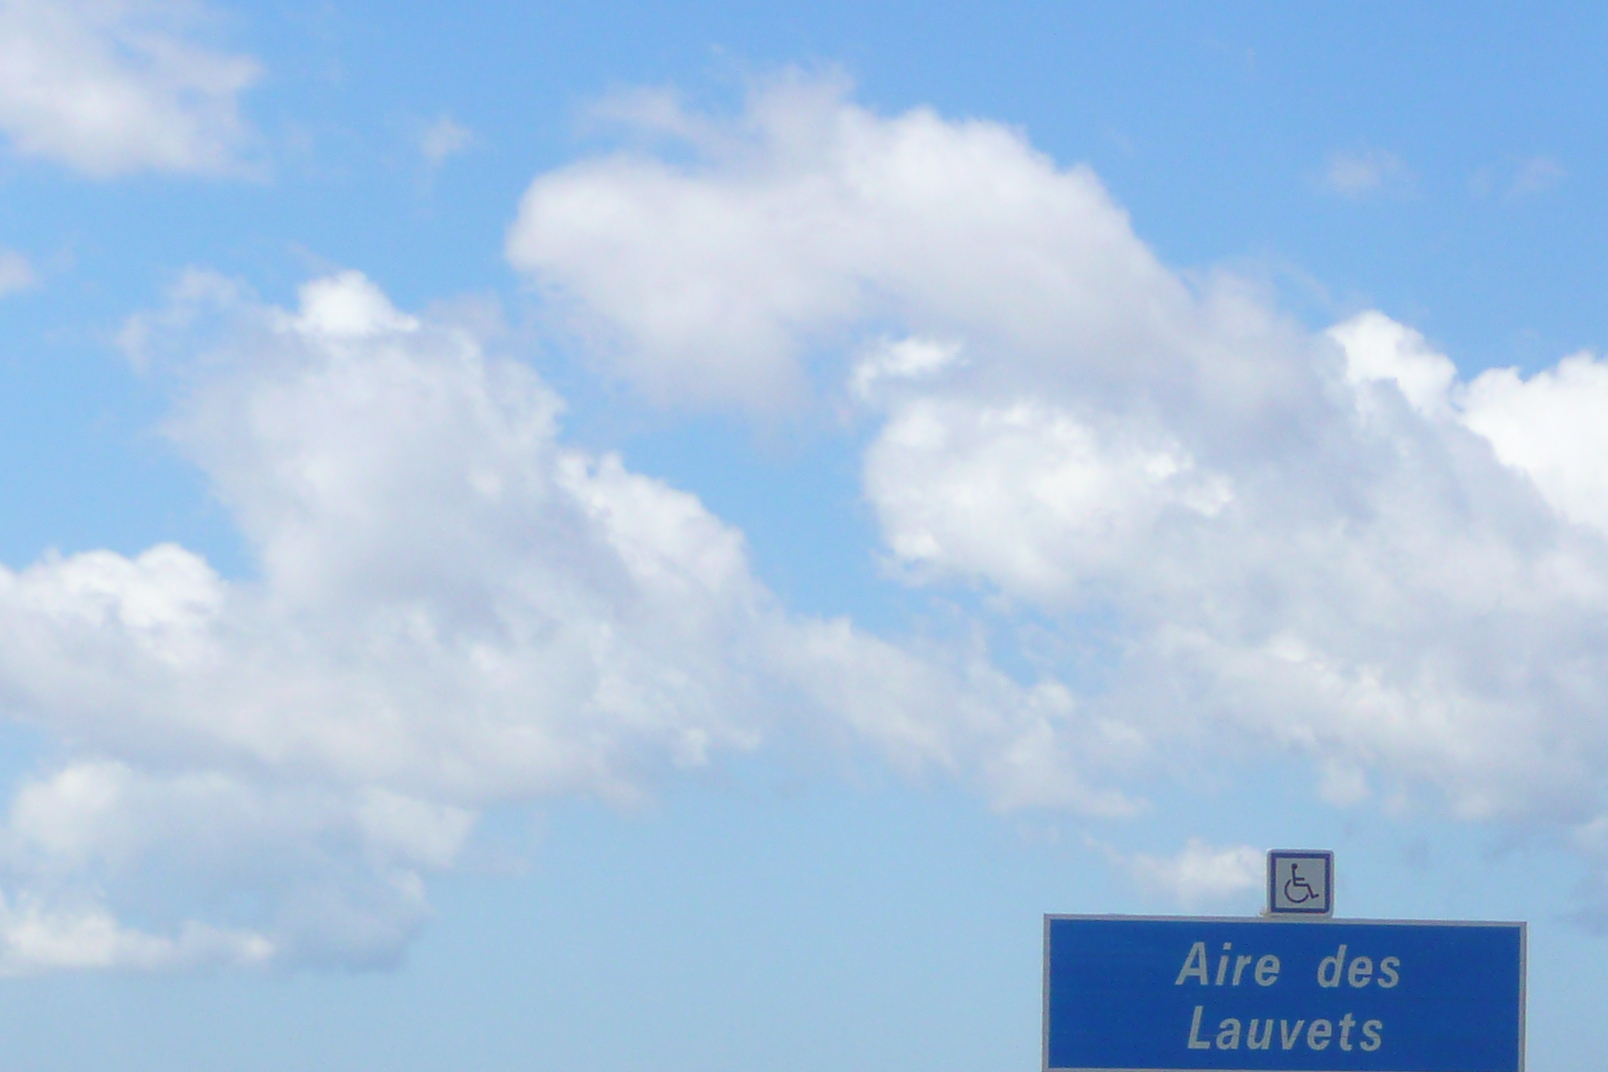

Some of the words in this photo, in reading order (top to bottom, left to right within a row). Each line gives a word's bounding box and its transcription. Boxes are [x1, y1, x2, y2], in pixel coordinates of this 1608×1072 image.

[1174, 941, 1280, 987] Aire
[1316, 943, 1401, 989] des
[1186, 1005, 1384, 1052] Lauvets
